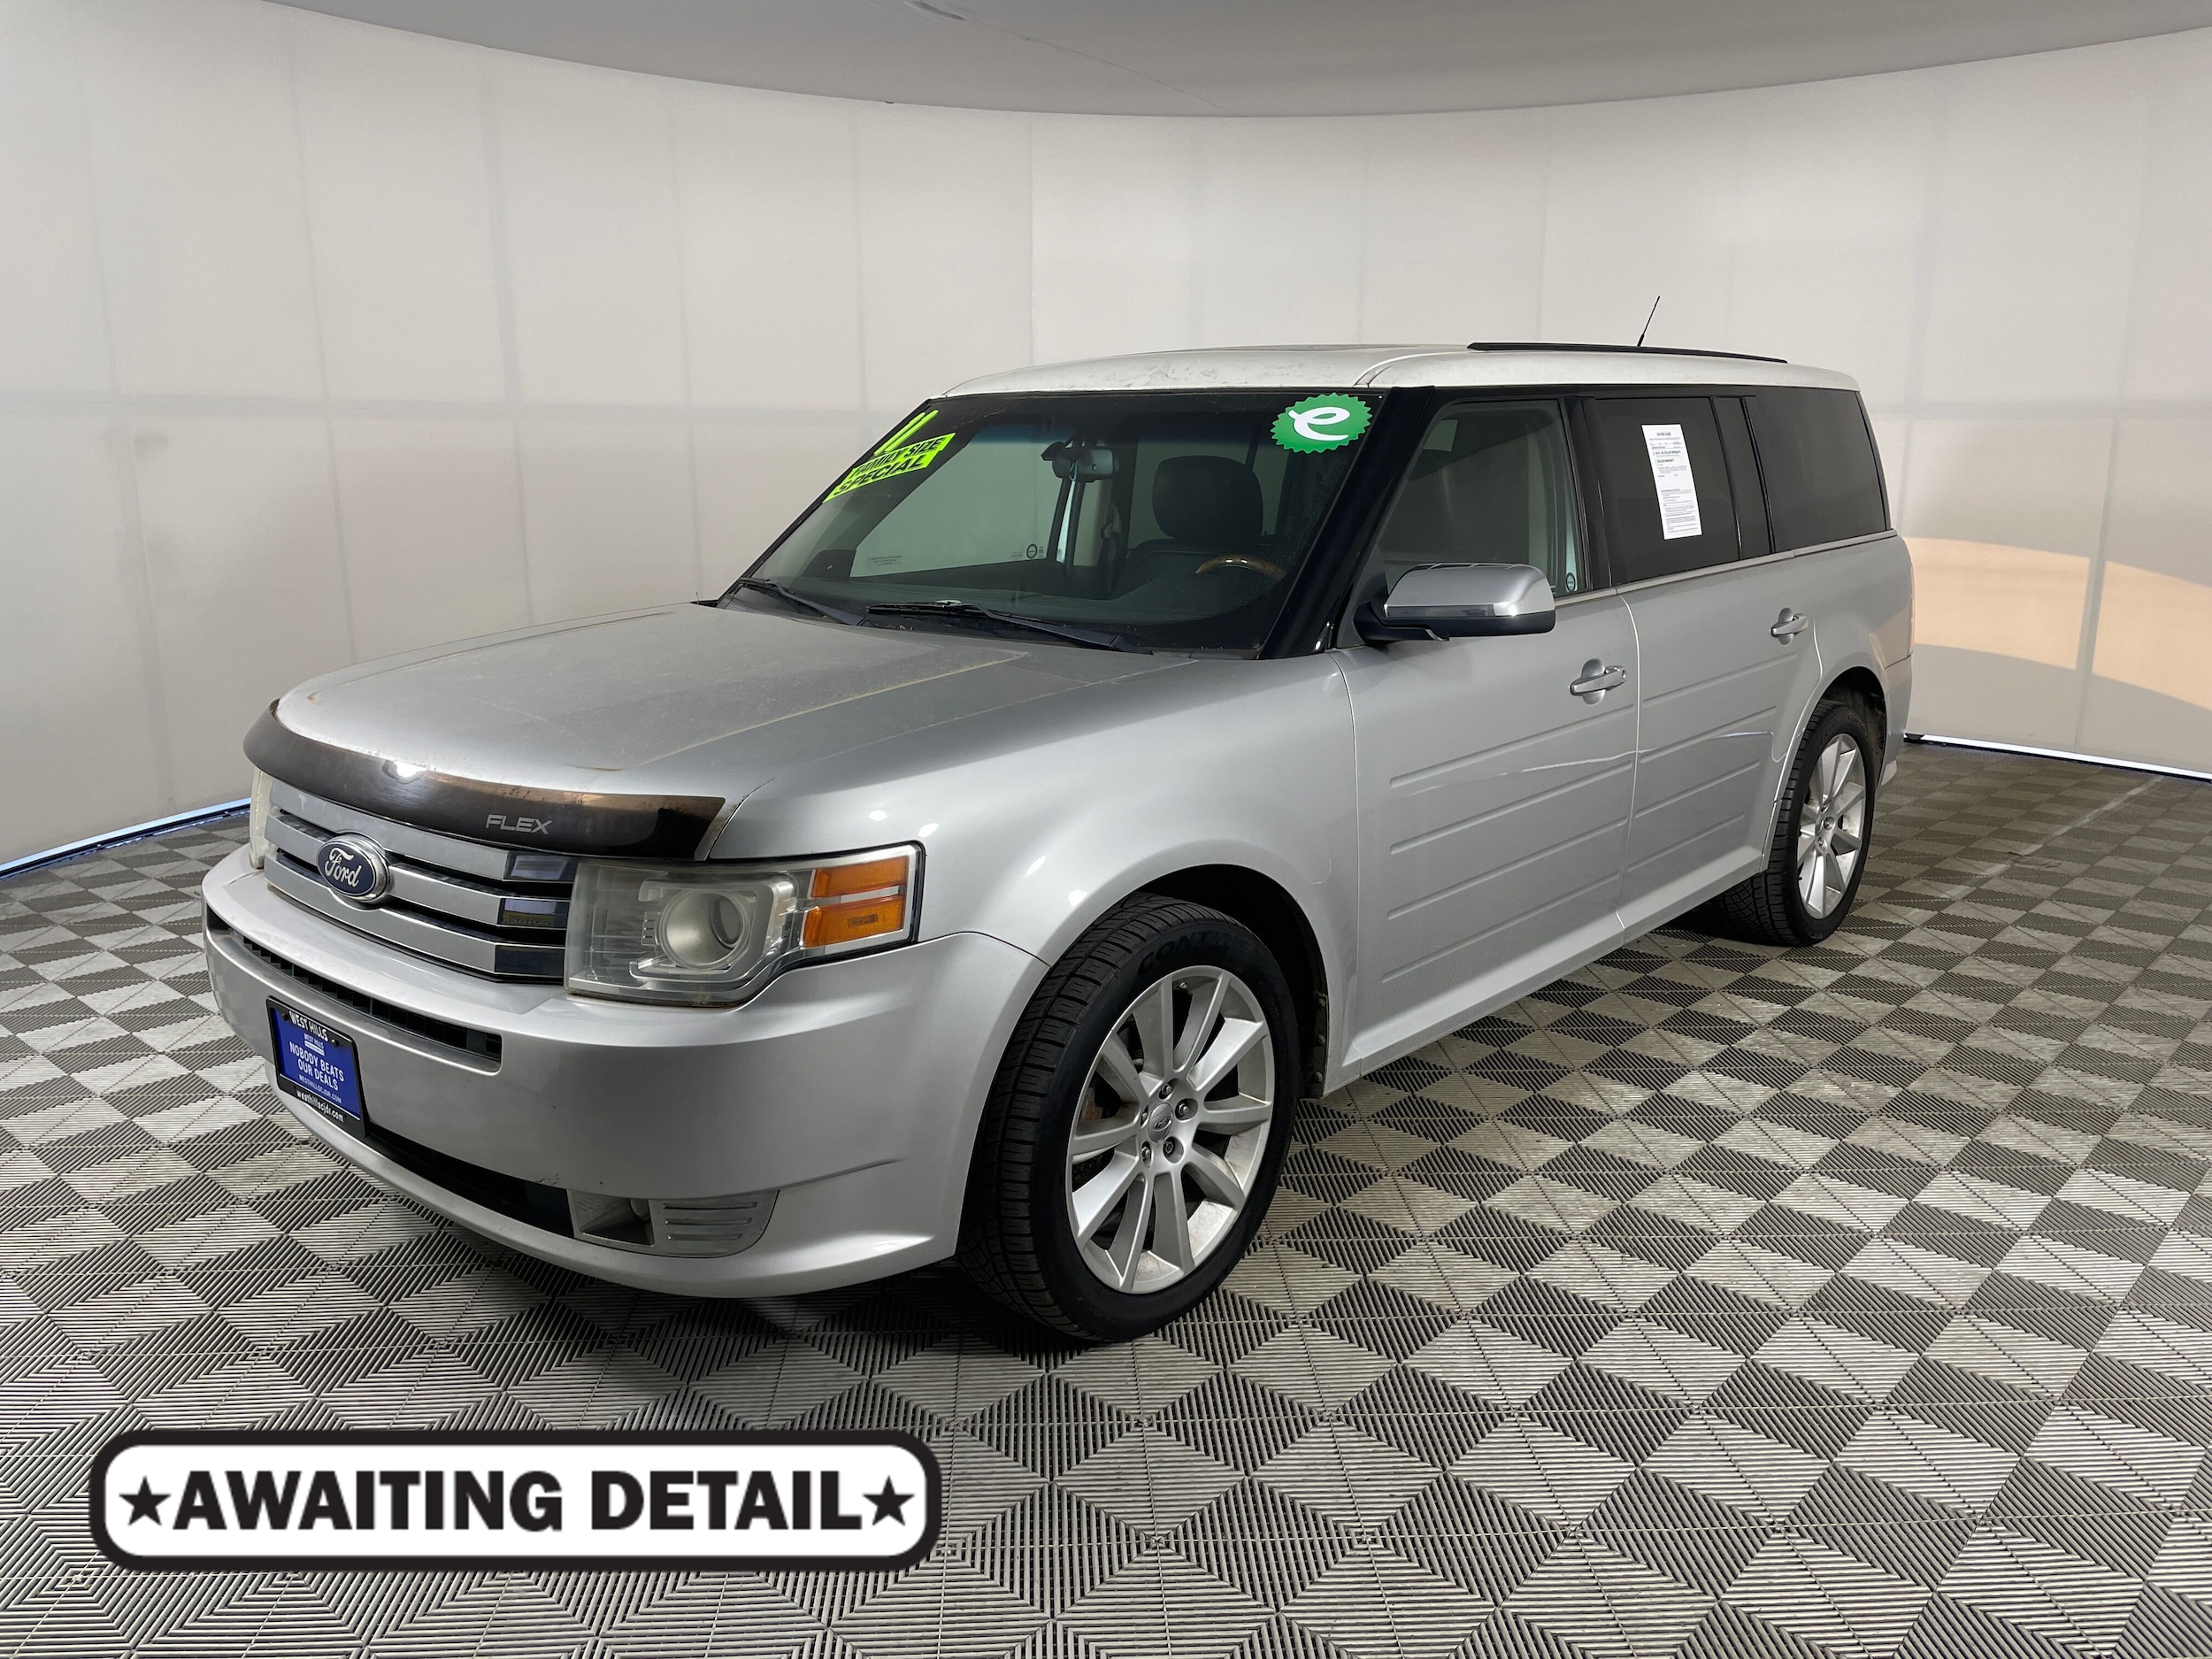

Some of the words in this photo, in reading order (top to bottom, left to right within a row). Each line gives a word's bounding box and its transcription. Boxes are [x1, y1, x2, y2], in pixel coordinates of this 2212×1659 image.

[903, 436, 946, 457] SIZE
[833, 454, 927, 495] SPECIAL
[485, 814, 553, 834] FLEX
[324, 847, 363, 887] Ford
[288, 1010, 309, 1030] WEST
[308, 1021, 328, 1041] HILLS
[288, 1041, 319, 1067] NOBODY
[319, 1059, 344, 1081] BEATS
[297, 1059, 313, 1077] OUR
[314, 1068, 338, 1090] DEALS
